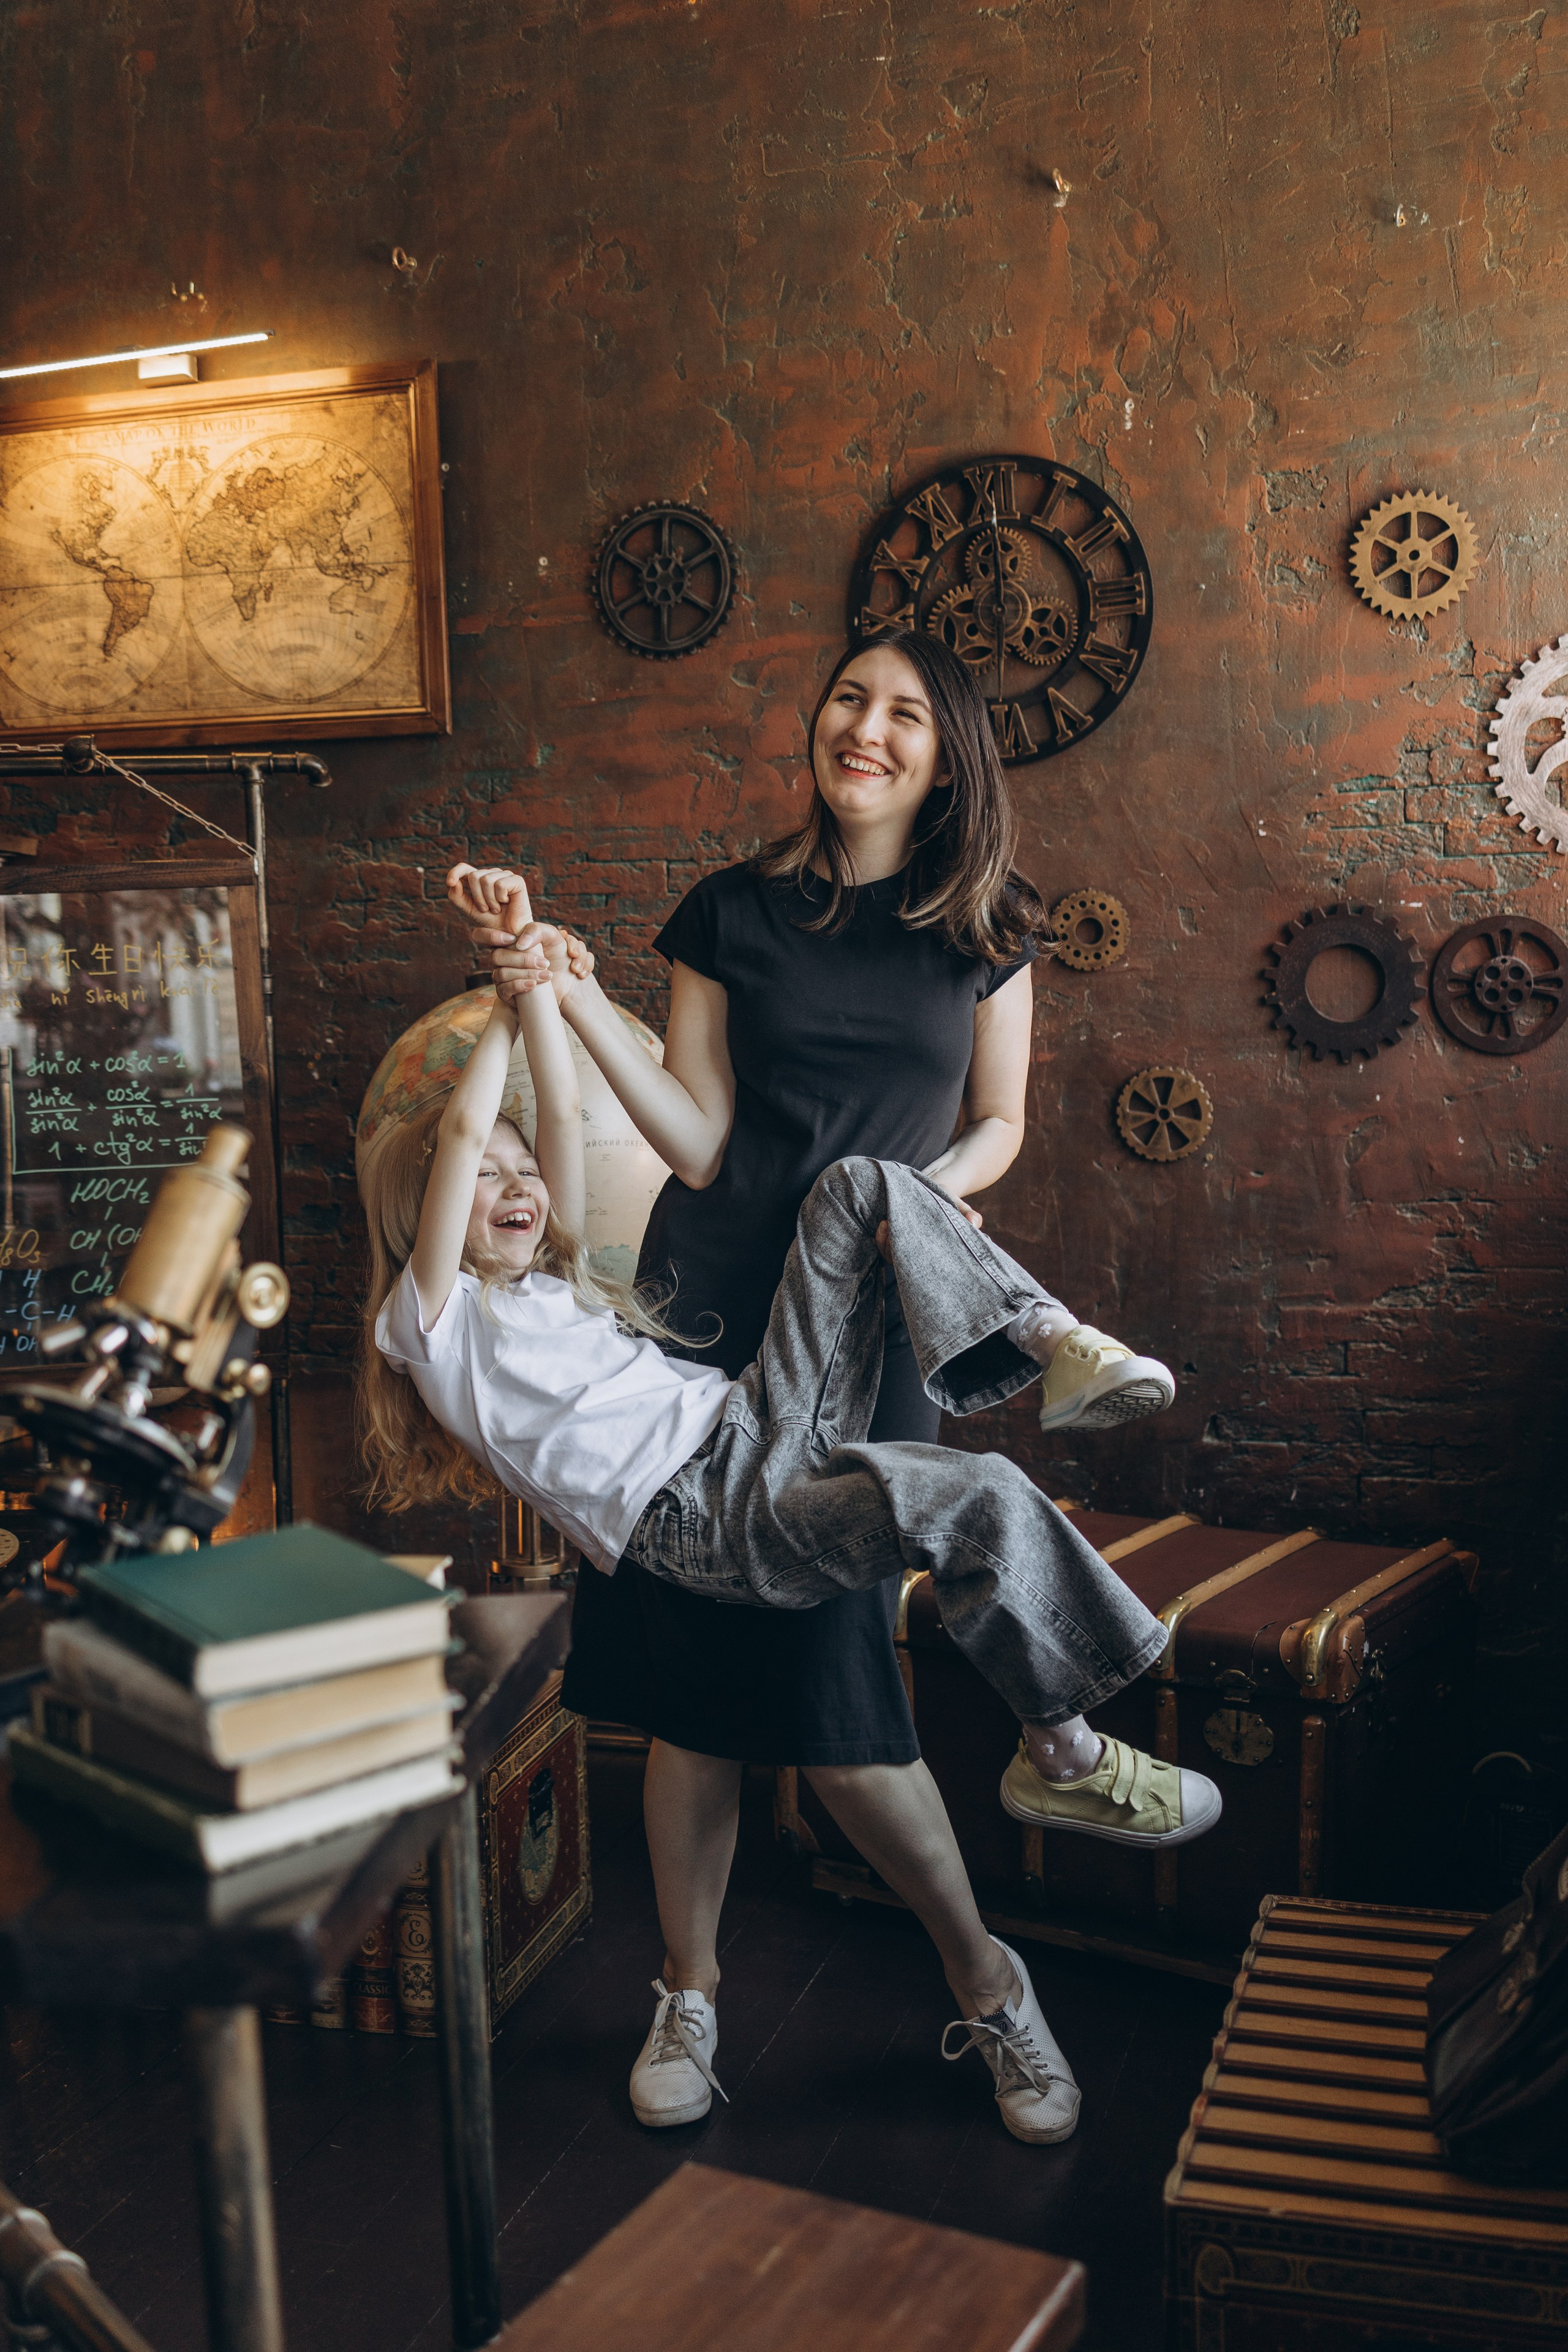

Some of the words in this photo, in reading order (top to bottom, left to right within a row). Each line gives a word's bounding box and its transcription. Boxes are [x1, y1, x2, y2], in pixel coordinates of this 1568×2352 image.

[203, 418, 257, 433] WORLD
[905, 483, 964, 551] XI
[963, 462, 1020, 527] XII
[870, 540, 930, 591] X
[1065, 507, 1131, 571] II
[1088, 572, 1146, 622] III
[1047, 687, 1093, 744] V
[583, 1139, 620, 1149] ИЙСКИЙ
